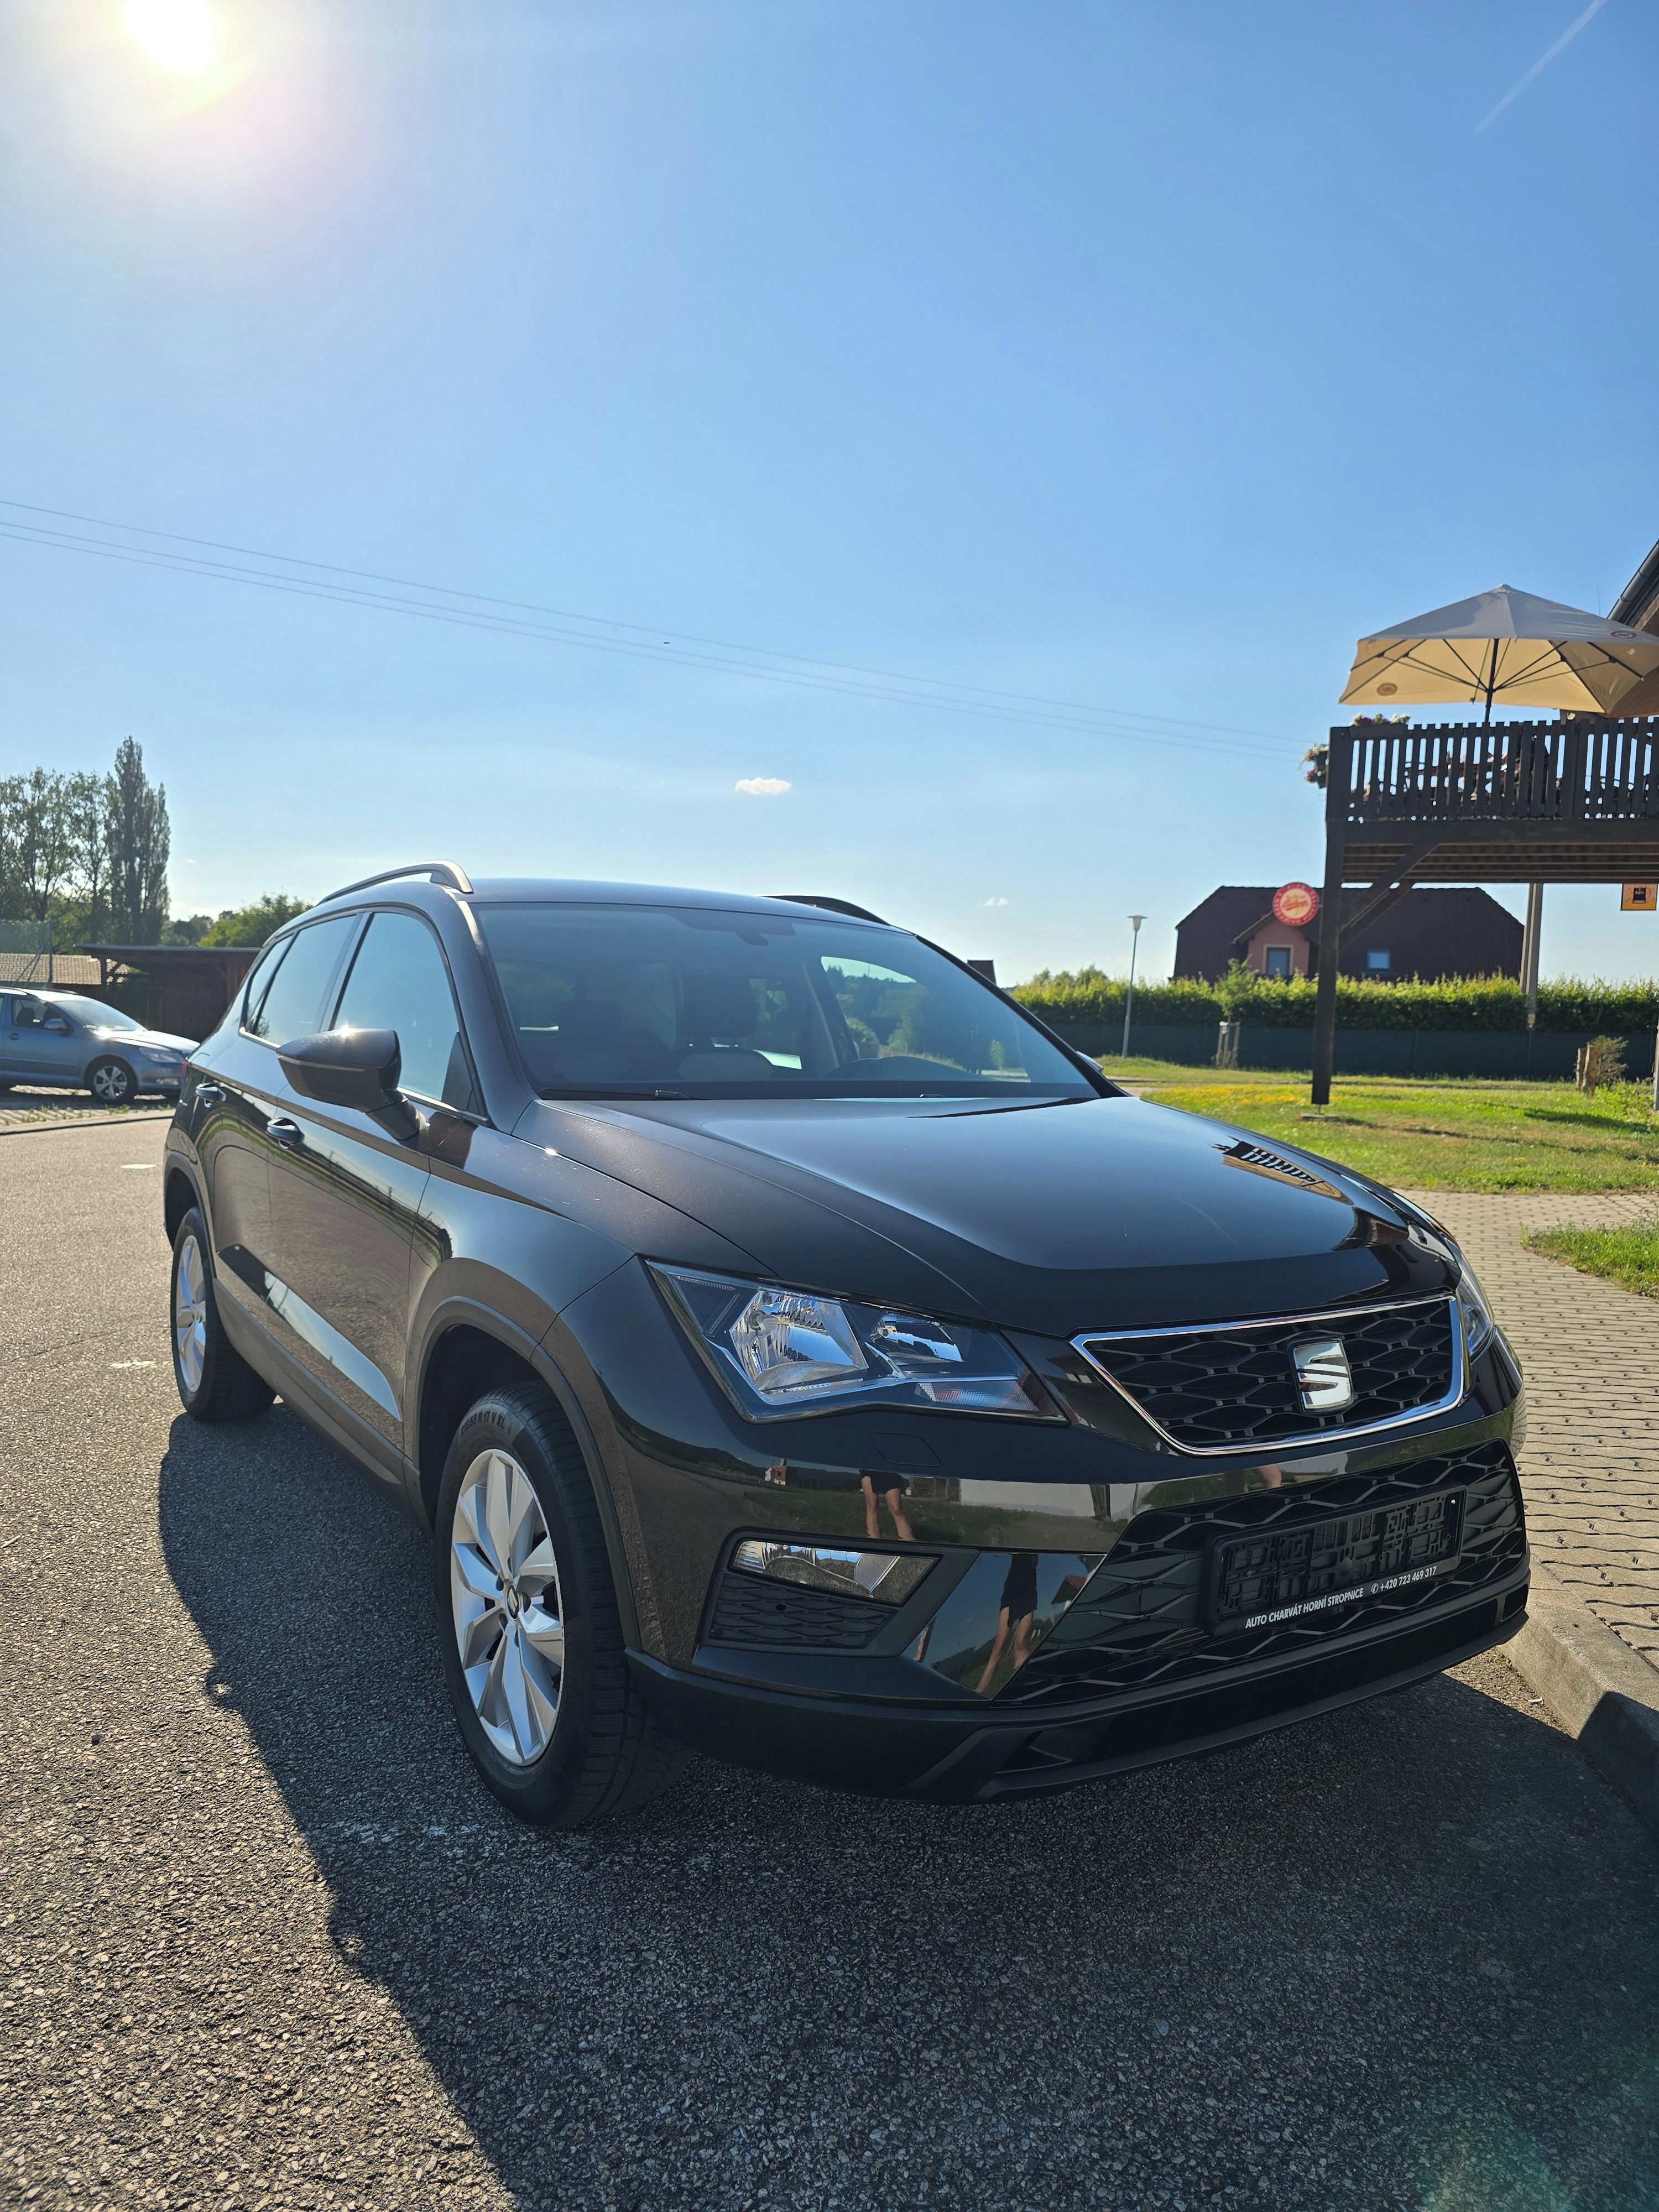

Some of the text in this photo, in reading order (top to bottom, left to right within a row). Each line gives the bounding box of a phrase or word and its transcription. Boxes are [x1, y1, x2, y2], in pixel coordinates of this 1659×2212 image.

[1245, 1566, 1437, 1629] AUTO CHARVÁT HORNÍ STROPNICE +420 723 469 317
